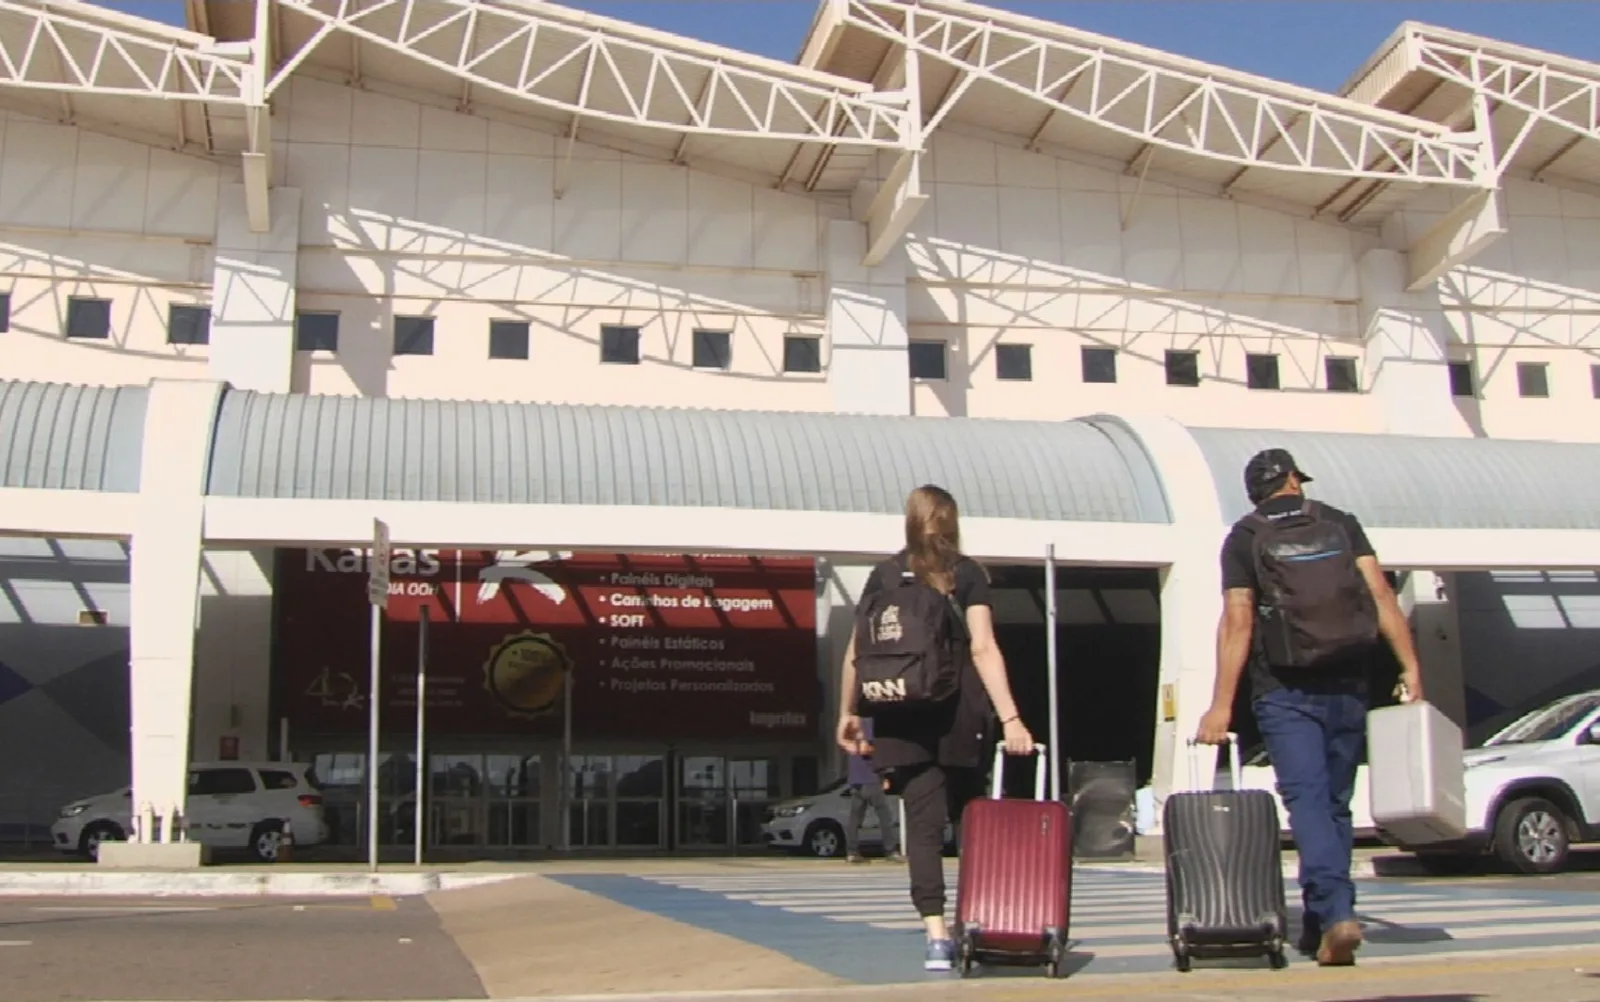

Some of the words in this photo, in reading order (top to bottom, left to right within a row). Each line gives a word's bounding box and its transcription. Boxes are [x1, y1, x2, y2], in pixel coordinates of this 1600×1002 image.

[610, 572, 660, 586] Painéis
[664, 573, 715, 588] Digitais
[681, 594, 701, 607] de
[610, 614, 645, 627] SOFT
[610, 635, 660, 649] Painéis
[664, 636, 725, 650] Estáticos
[611, 656, 657, 671] Ações
[660, 657, 756, 672] Promocionais
[610, 677, 667, 693] Projetos
[670, 678, 775, 692] Personalizados
